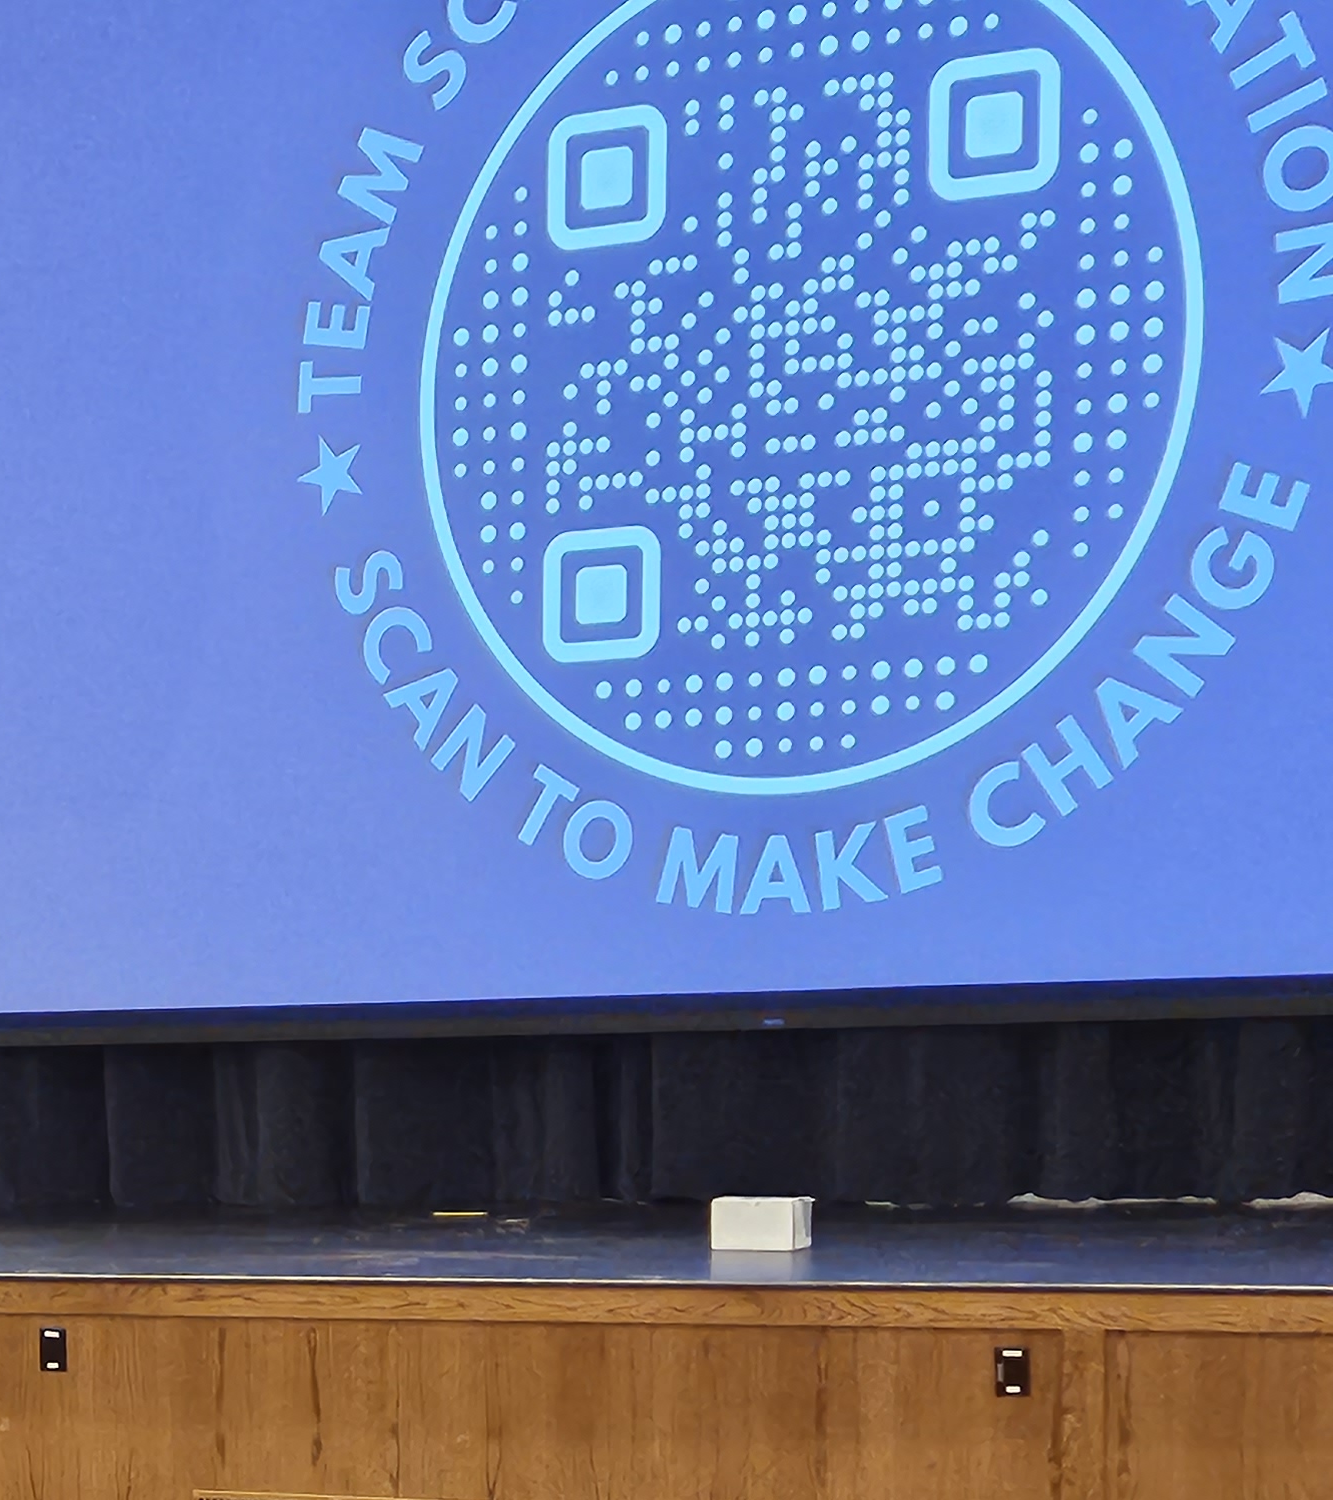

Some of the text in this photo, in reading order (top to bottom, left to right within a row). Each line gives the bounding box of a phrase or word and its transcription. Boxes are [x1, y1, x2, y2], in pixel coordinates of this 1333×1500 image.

[298, 127, 424, 413] TEAM
[335, 462, 1310, 914] SCAN TO MAKE CHANGE
